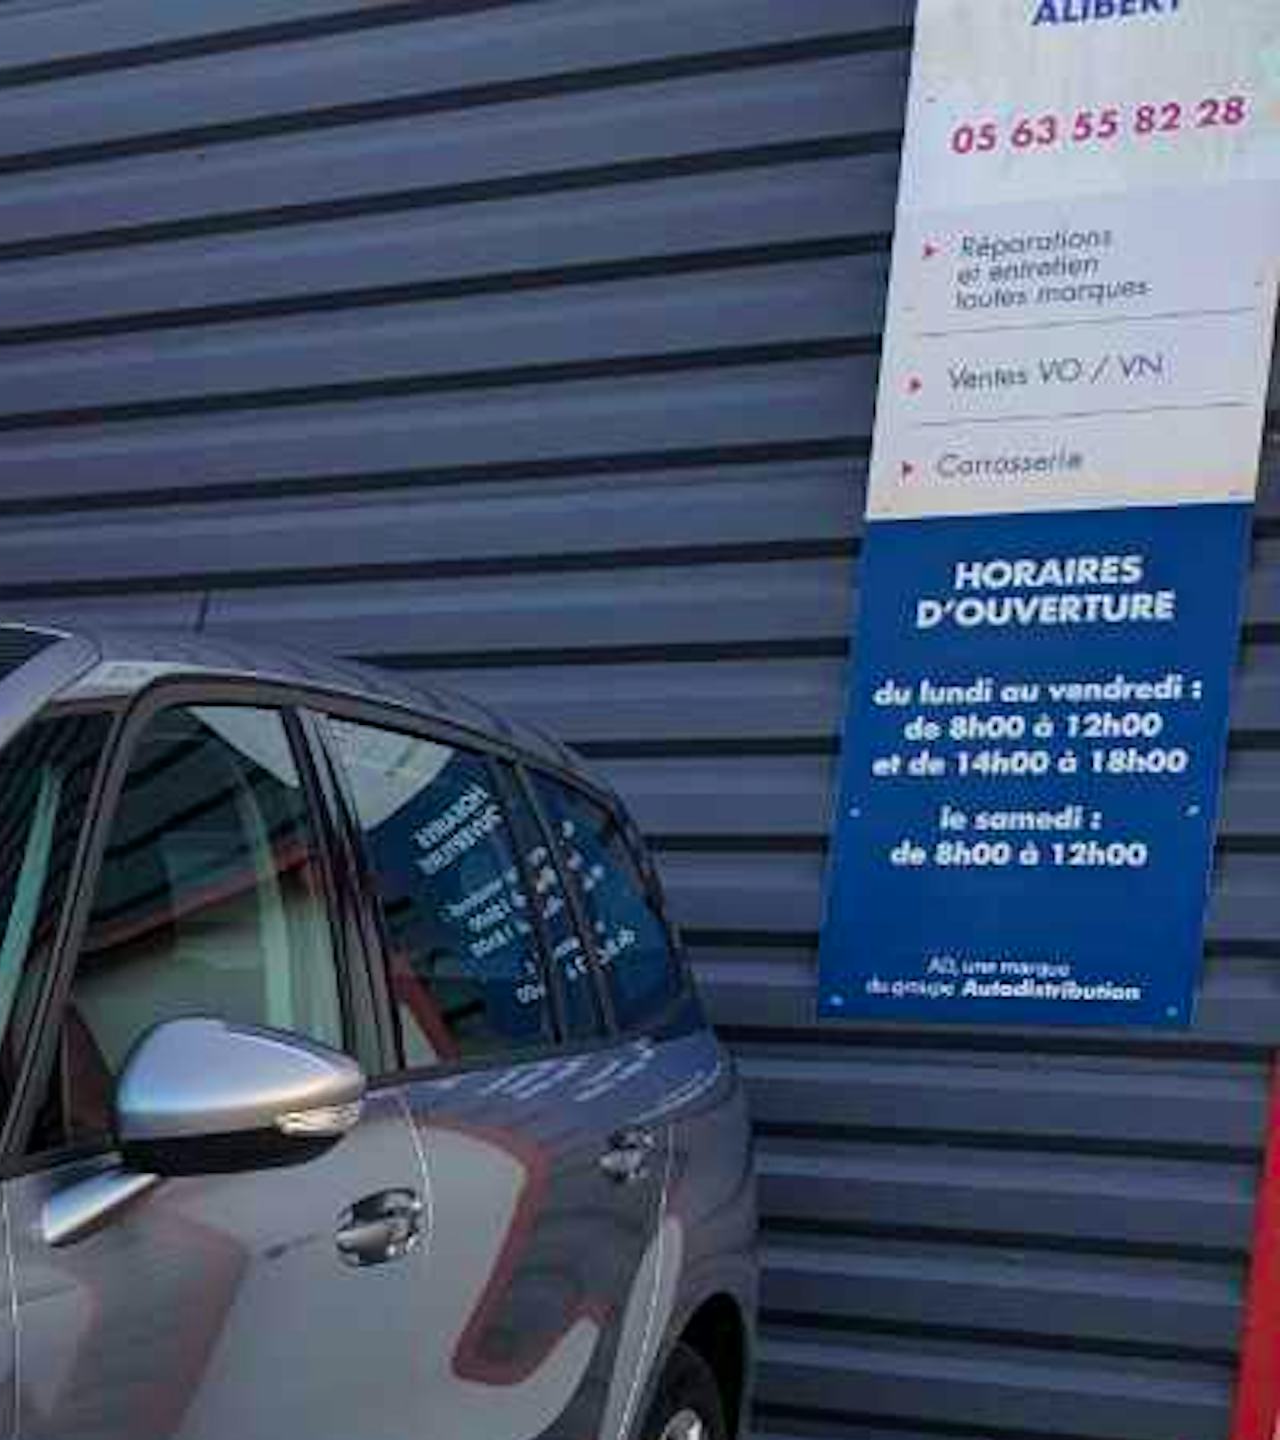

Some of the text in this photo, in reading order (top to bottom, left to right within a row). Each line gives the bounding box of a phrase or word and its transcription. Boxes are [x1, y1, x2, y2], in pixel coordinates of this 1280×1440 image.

[951, 96, 1245, 153] 05 63 55 82 28
[962, 230, 1112, 261] Réparations
[957, 256, 1099, 286] et entretien
[956, 279, 1149, 310] toutes marques
[948, 366, 1028, 389] Ventes
[1040, 357, 1081, 383] VO
[1120, 353, 1163, 379] VN
[937, 446, 1082, 477] Carrosserie
[955, 555, 1144, 590] HORAIRES
[916, 590, 1175, 629] D'OUVERTURE
[873, 681, 911, 705] du
[920, 677, 992, 704] lundi
[1000, 683, 1038, 703] au
[1048, 674, 1183, 702] vendredi
[904, 712, 1163, 741] de 8h00 à 12h00
[872, 748, 1189, 776] et de 14h00 à 18h00
[941, 804, 968, 831] le
[974, 804, 1083, 831] samedi
[891, 840, 1148, 867] de 8h00 à 12h00
[962, 960, 996, 975] une
[1000, 959, 1071, 978] marque
[866, 974, 1141, 1000] du groupe Autodistribution
